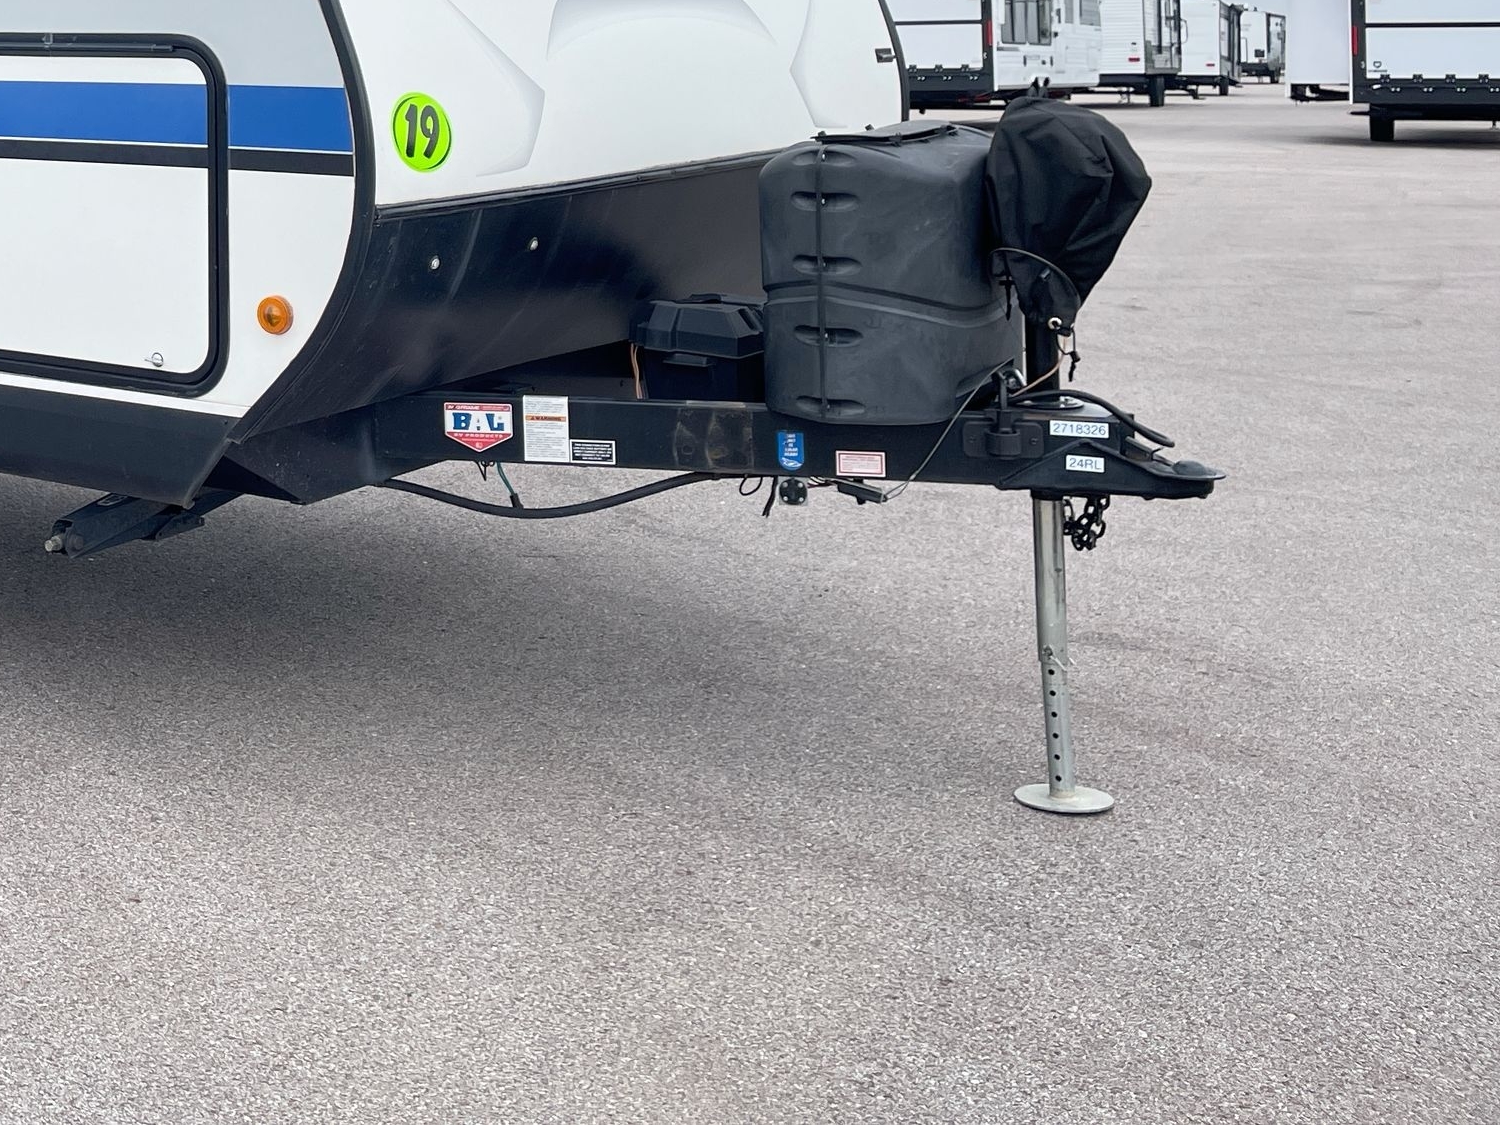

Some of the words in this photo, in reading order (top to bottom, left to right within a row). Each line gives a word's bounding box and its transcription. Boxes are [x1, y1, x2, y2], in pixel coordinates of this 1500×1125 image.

[405, 103, 440, 159] 19
[1053, 422, 1107, 436] 2718326
[1069, 457, 1102, 470] 24RL
